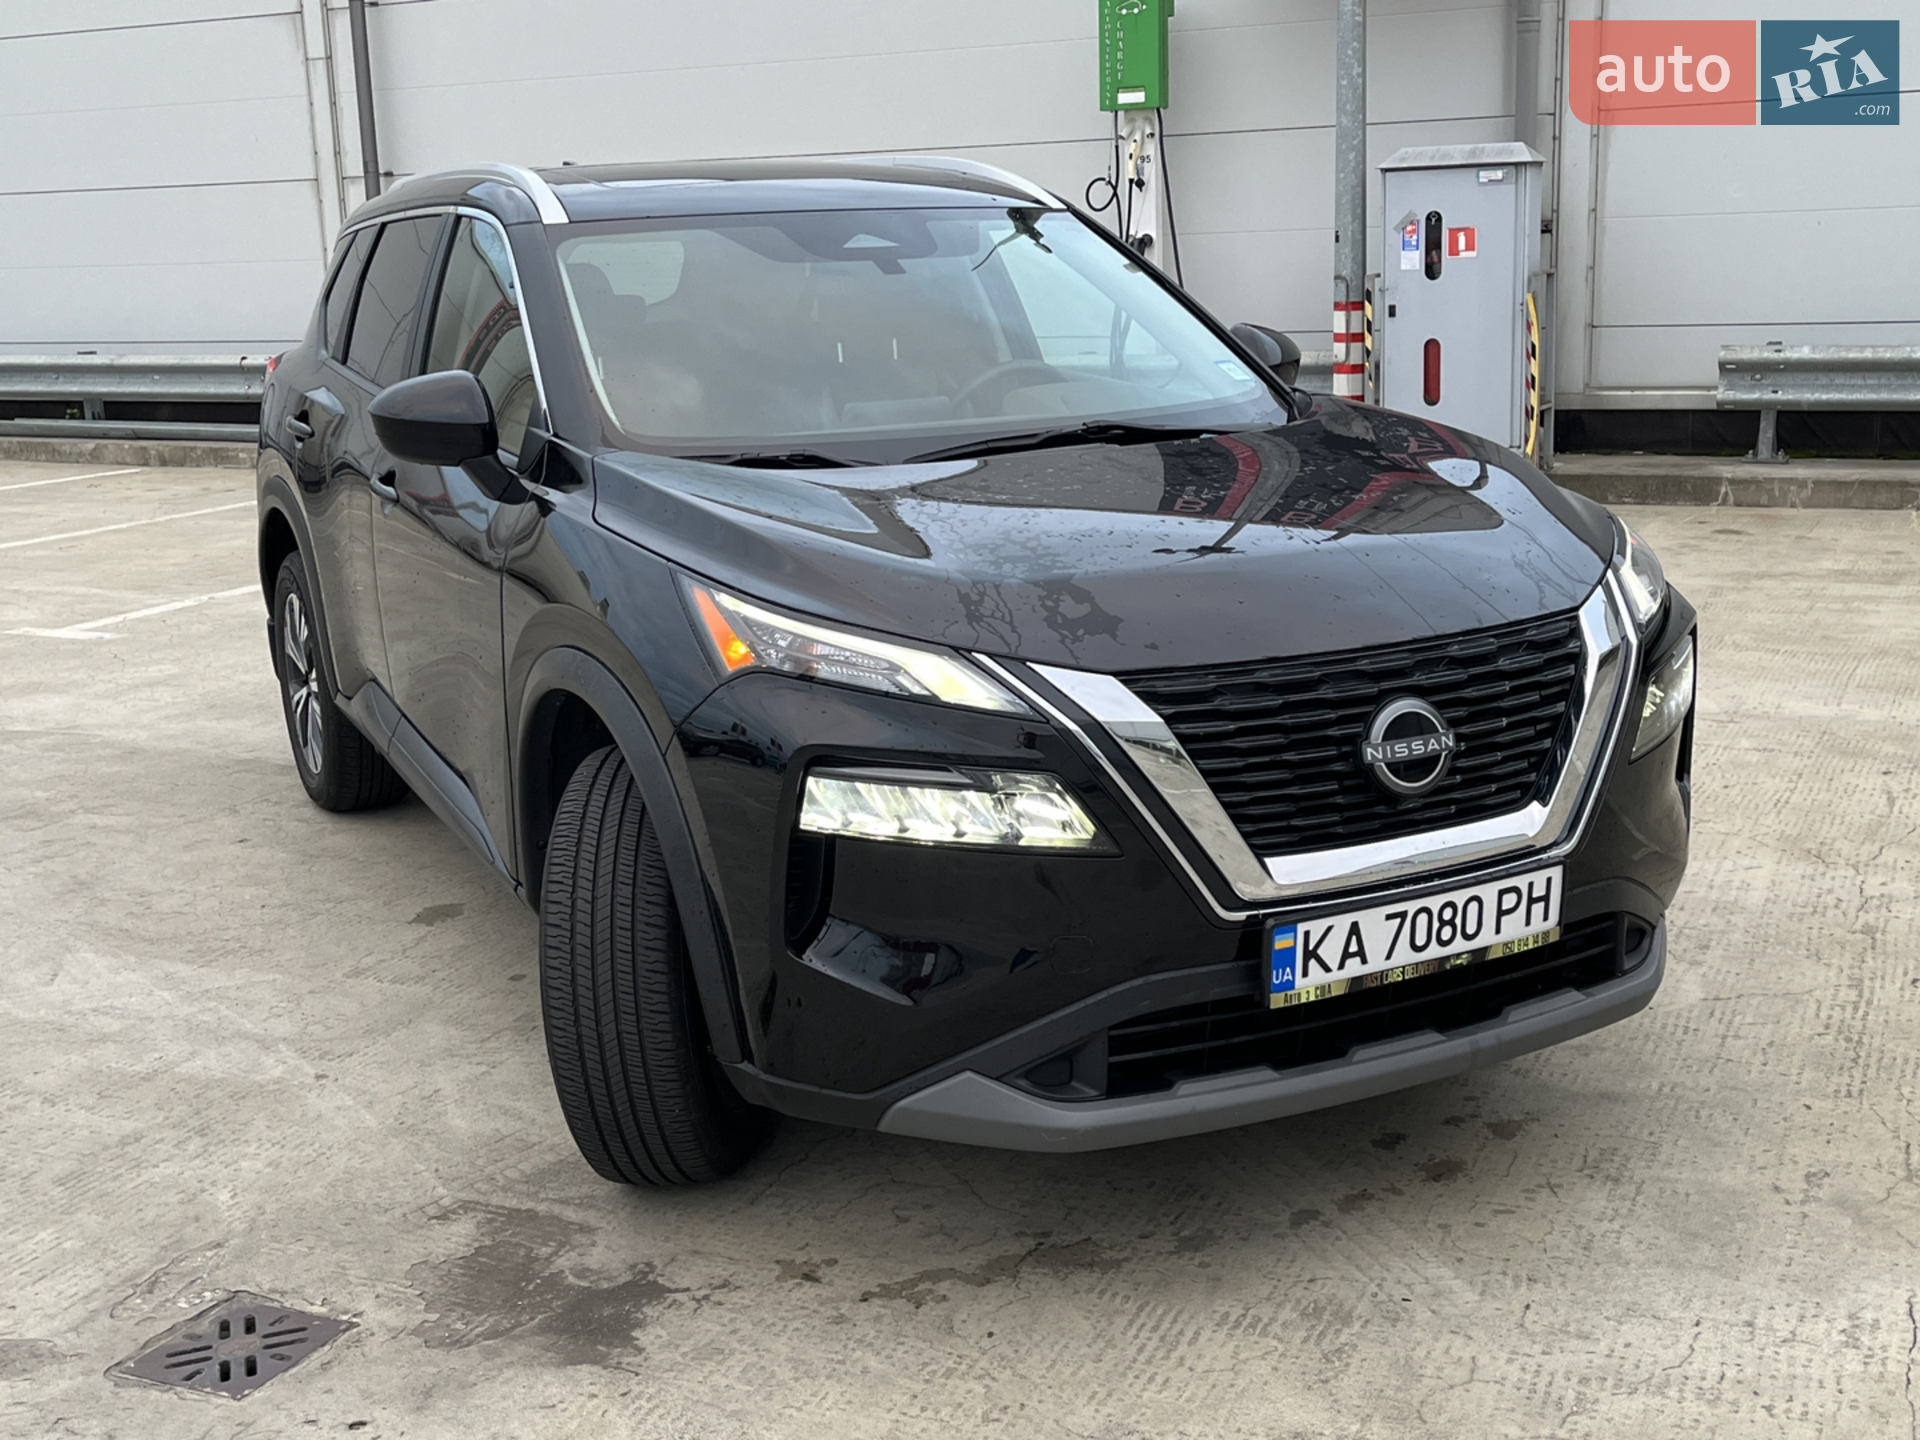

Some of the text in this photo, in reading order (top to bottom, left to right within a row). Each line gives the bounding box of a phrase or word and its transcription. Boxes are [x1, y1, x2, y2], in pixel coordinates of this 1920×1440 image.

[1116, 20, 1124, 80] CHARGE
[1366, 733, 1453, 761] NISSAN
[1301, 876, 1552, 979] KA 7080 PH
[1272, 966, 1293, 985] UA
[1362, 959, 1439, 989] FAST CARS DELIVERY
